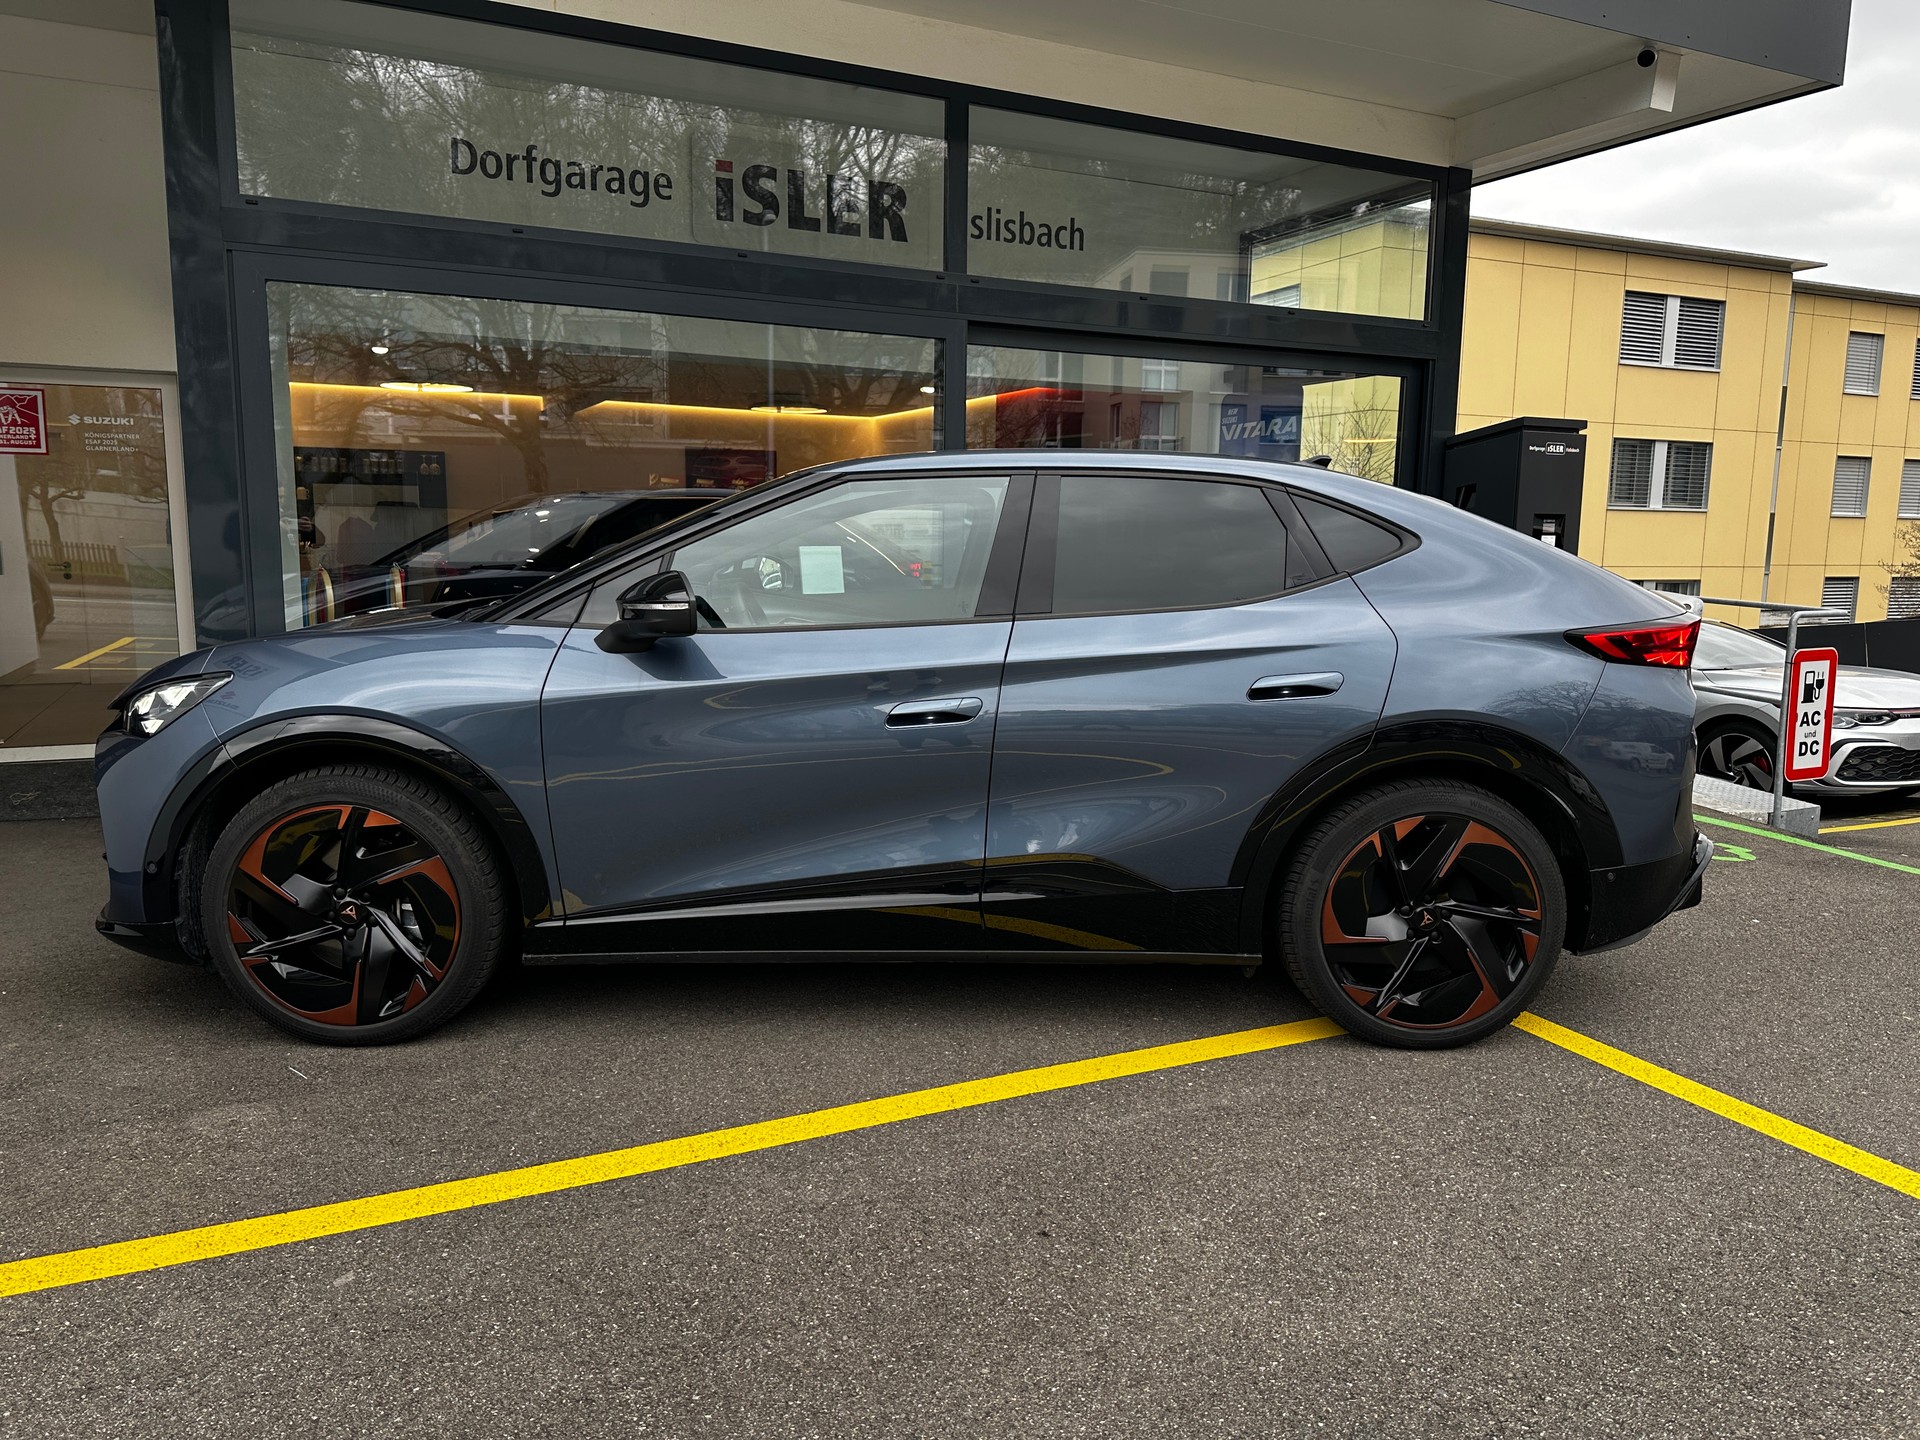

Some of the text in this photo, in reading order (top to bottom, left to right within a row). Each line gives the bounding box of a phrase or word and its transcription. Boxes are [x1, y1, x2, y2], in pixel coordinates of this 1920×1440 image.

[450, 136, 1085, 252] Dorfgarage iSLER slisbach
[83, 416, 134, 425] SUZUKI
[1221, 415, 1297, 440] VITARA
[1799, 710, 1821, 727] AC
[1804, 730, 1816, 738] und
[1798, 740, 1820, 757] DC
